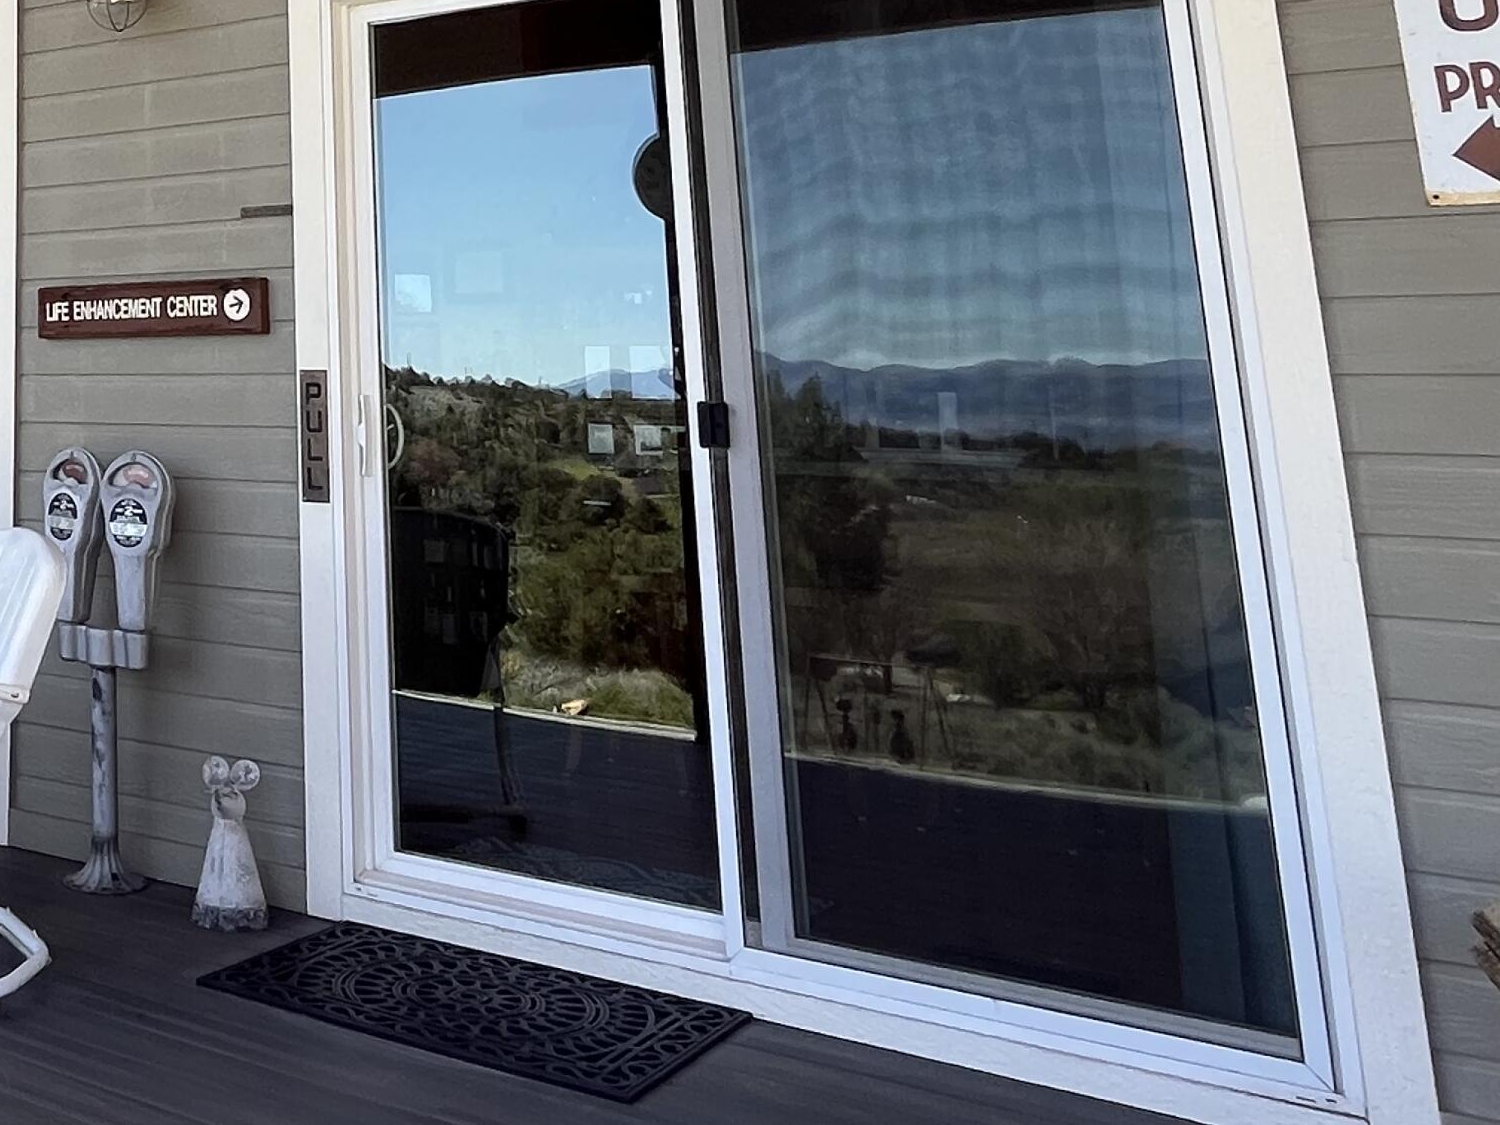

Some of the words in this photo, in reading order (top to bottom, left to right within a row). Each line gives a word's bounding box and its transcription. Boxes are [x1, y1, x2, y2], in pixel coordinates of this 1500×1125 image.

[46, 301, 70, 322] LIFE
[73, 297, 163, 322] ENHANCEMENT
[167, 294, 218, 319] CENTER
[305, 382, 323, 491] PULL
